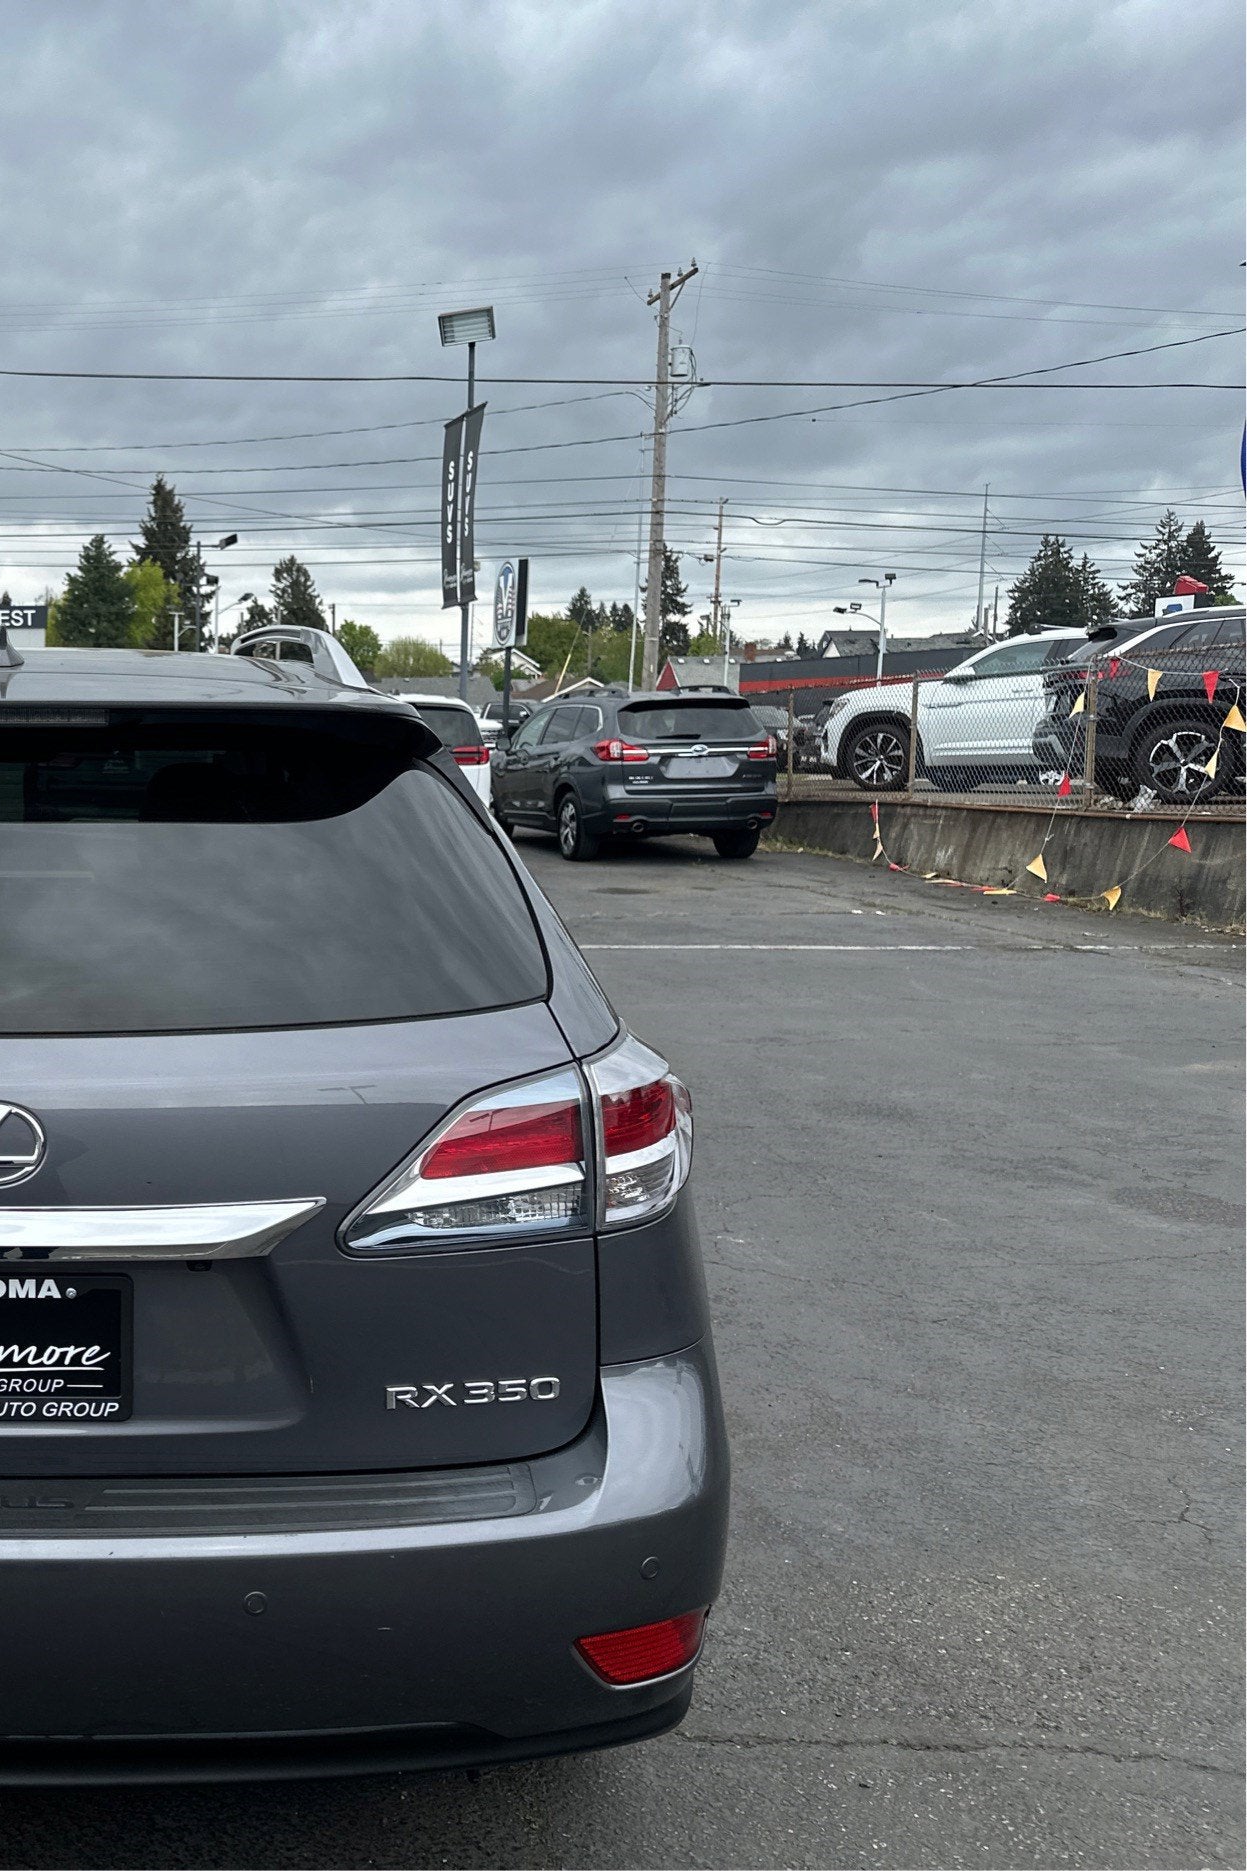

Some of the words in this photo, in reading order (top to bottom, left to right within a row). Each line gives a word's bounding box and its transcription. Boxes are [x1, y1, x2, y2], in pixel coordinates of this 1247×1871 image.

[446, 460, 455, 544] SUVS
[384, 1383, 457, 1409] RX
[463, 1376, 560, 1403] 350
[42, 1402, 119, 1417] GROUP
